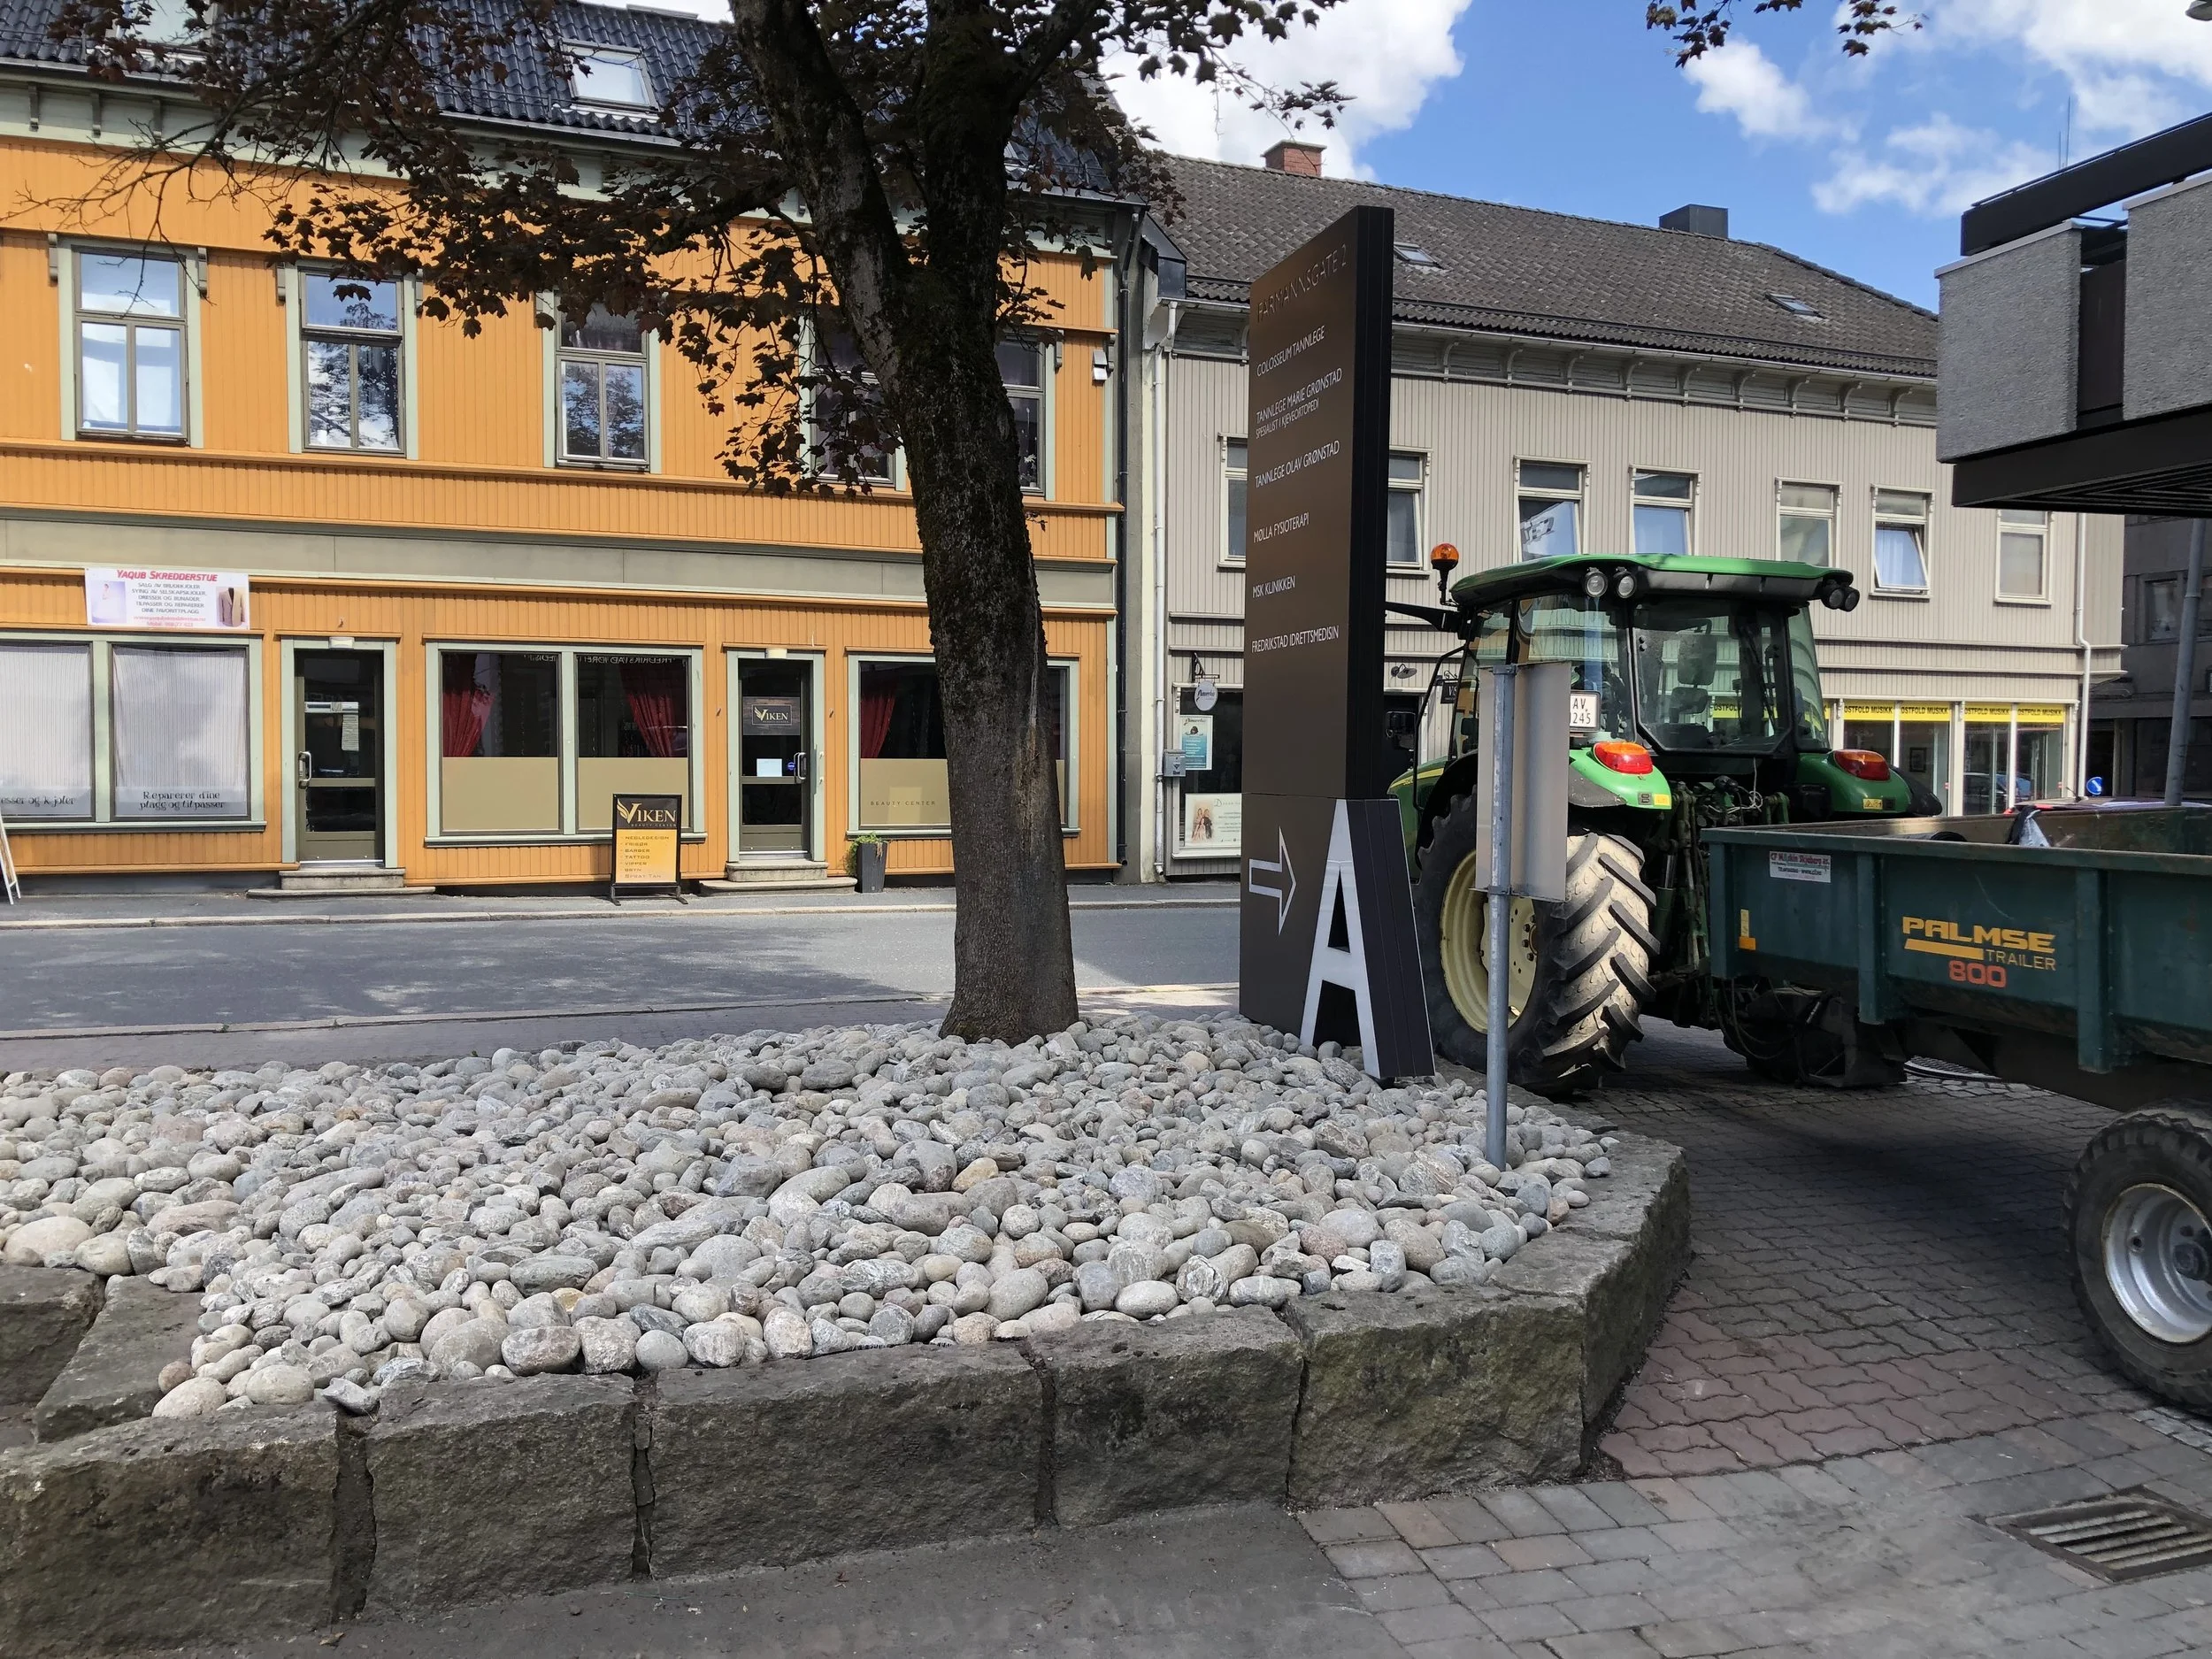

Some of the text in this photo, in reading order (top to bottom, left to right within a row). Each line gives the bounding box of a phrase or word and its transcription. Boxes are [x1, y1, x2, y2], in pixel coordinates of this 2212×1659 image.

[1256, 325, 1325, 377] COLOSSEUM TANNLEGE
[1256, 368, 1342, 424] TANNLEGE MARIE GRØNSTAD
[1256, 419, 1279, 439] SPESIALIST
[1281, 397, 1319, 428] KJEVEORTOPEDI
[1256, 441, 1340, 488] TANNLEGE OLAV GRØNSTAD
[1253, 512, 1309, 543] MØLLA FYSIOTERAPI
[117, 570, 219, 581] YAQUB SKREDDERSTUE
[1252, 575, 1295, 598] MSK KLINIKKEN
[1251, 625, 1339, 653] FREDRIKSTAD IDRETTSMEDISIN
[755, 707, 788, 721] VIKEN
[1573, 698, 1586, 710] AV
[1570, 712, 1591, 725] 245
[139, 800, 224, 810] plagg og tilpasser
[142, 790, 220, 800] Reparerer dine
[617, 798, 676, 824] VIKEN
[1299, 799, 1380, 1079] A
[1902, 916, 2055, 954] PALMSE
[1948, 959, 2007, 988] 800
[1985, 949, 2056, 971] TRAILER
